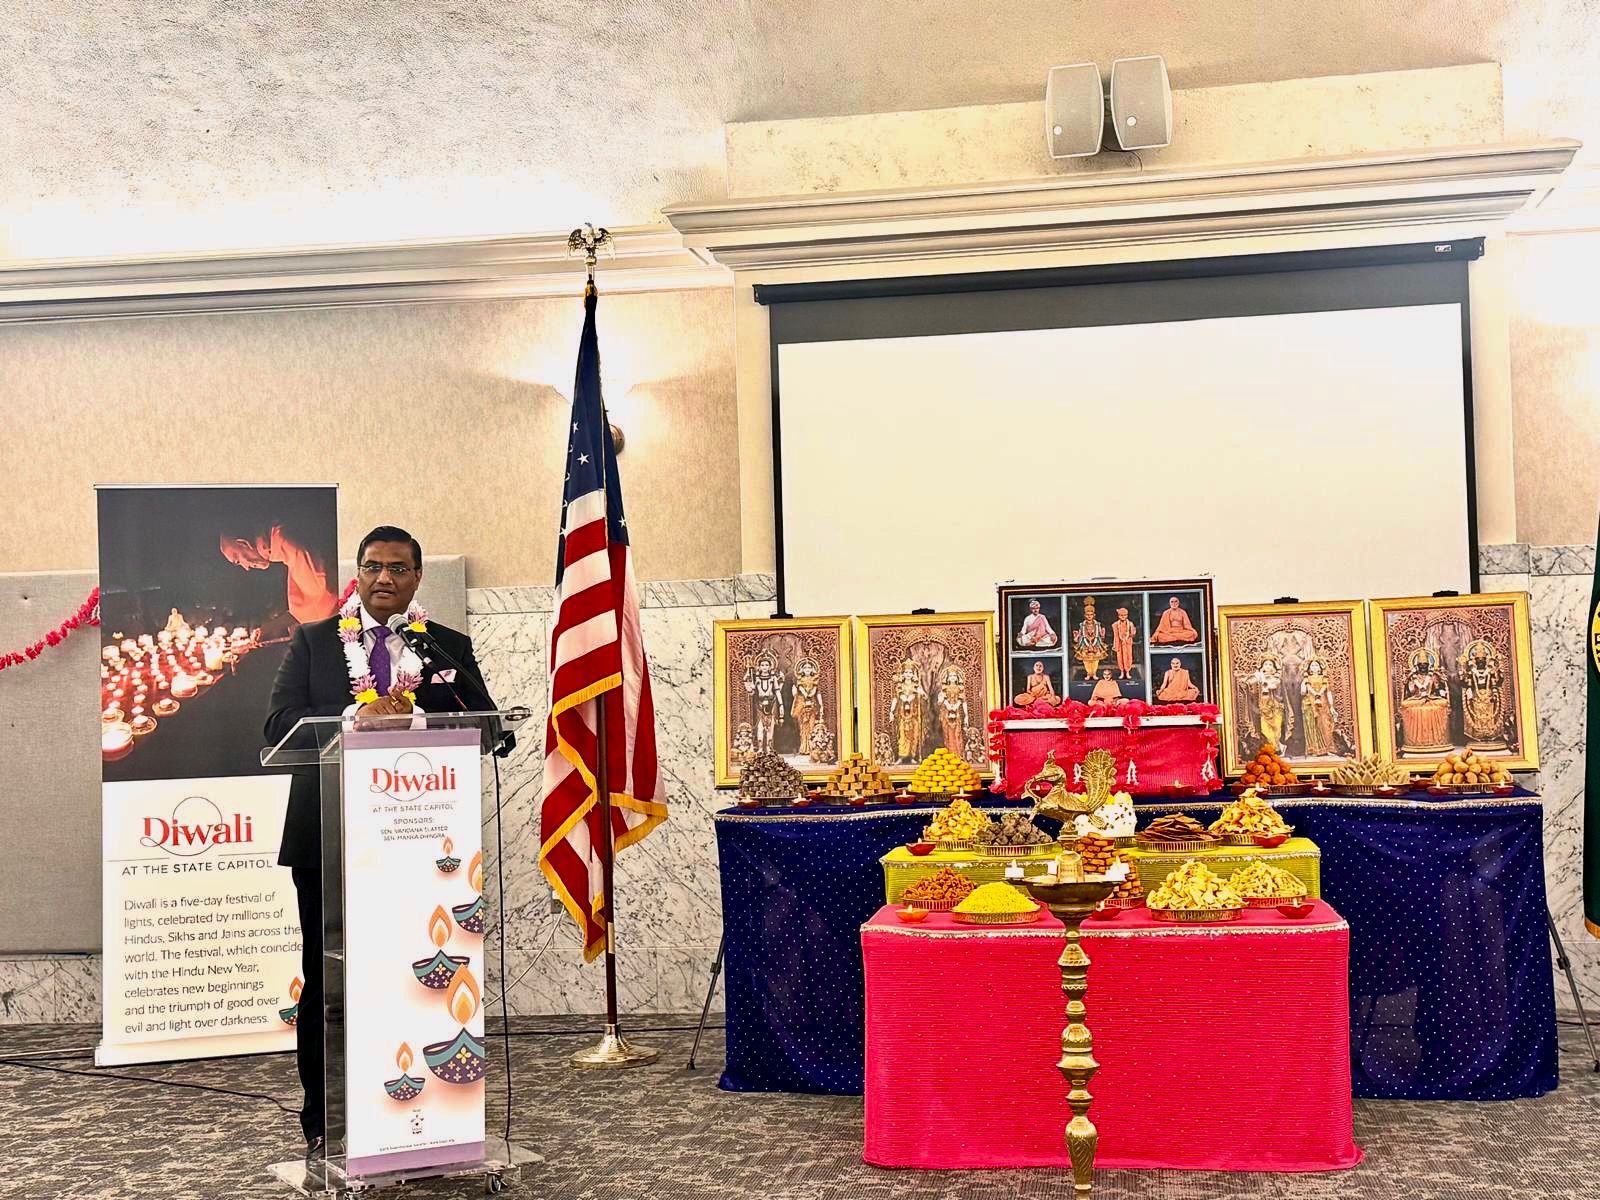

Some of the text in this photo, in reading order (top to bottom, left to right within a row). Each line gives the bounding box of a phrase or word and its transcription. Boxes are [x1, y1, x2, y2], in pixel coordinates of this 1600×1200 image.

[370, 766, 456, 793] Diwali
[424, 803, 454, 811] CAPITOL
[140, 813, 253, 847] Diwali
[122, 860, 273, 875] AT THE STATE CAPITOL
[124, 891, 276, 911] Diwali is a five-day festival of
[124, 908, 284, 929] lights, celebrated by millions of
[124, 925, 301, 945] Hindus, Sikhs and Jains across the
[124, 952, 157, 963] world.
[161, 949, 181, 961] The
[184, 946, 223, 959] festival,
[226, 944, 258, 956] which
[124, 962, 260, 980] with the Hindu New Year,
[124, 980, 264, 998] celebrates new beginnings
[124, 995, 280, 1016] and the triumph of good over
[124, 1014, 269, 1033] evil and light over darkness.
